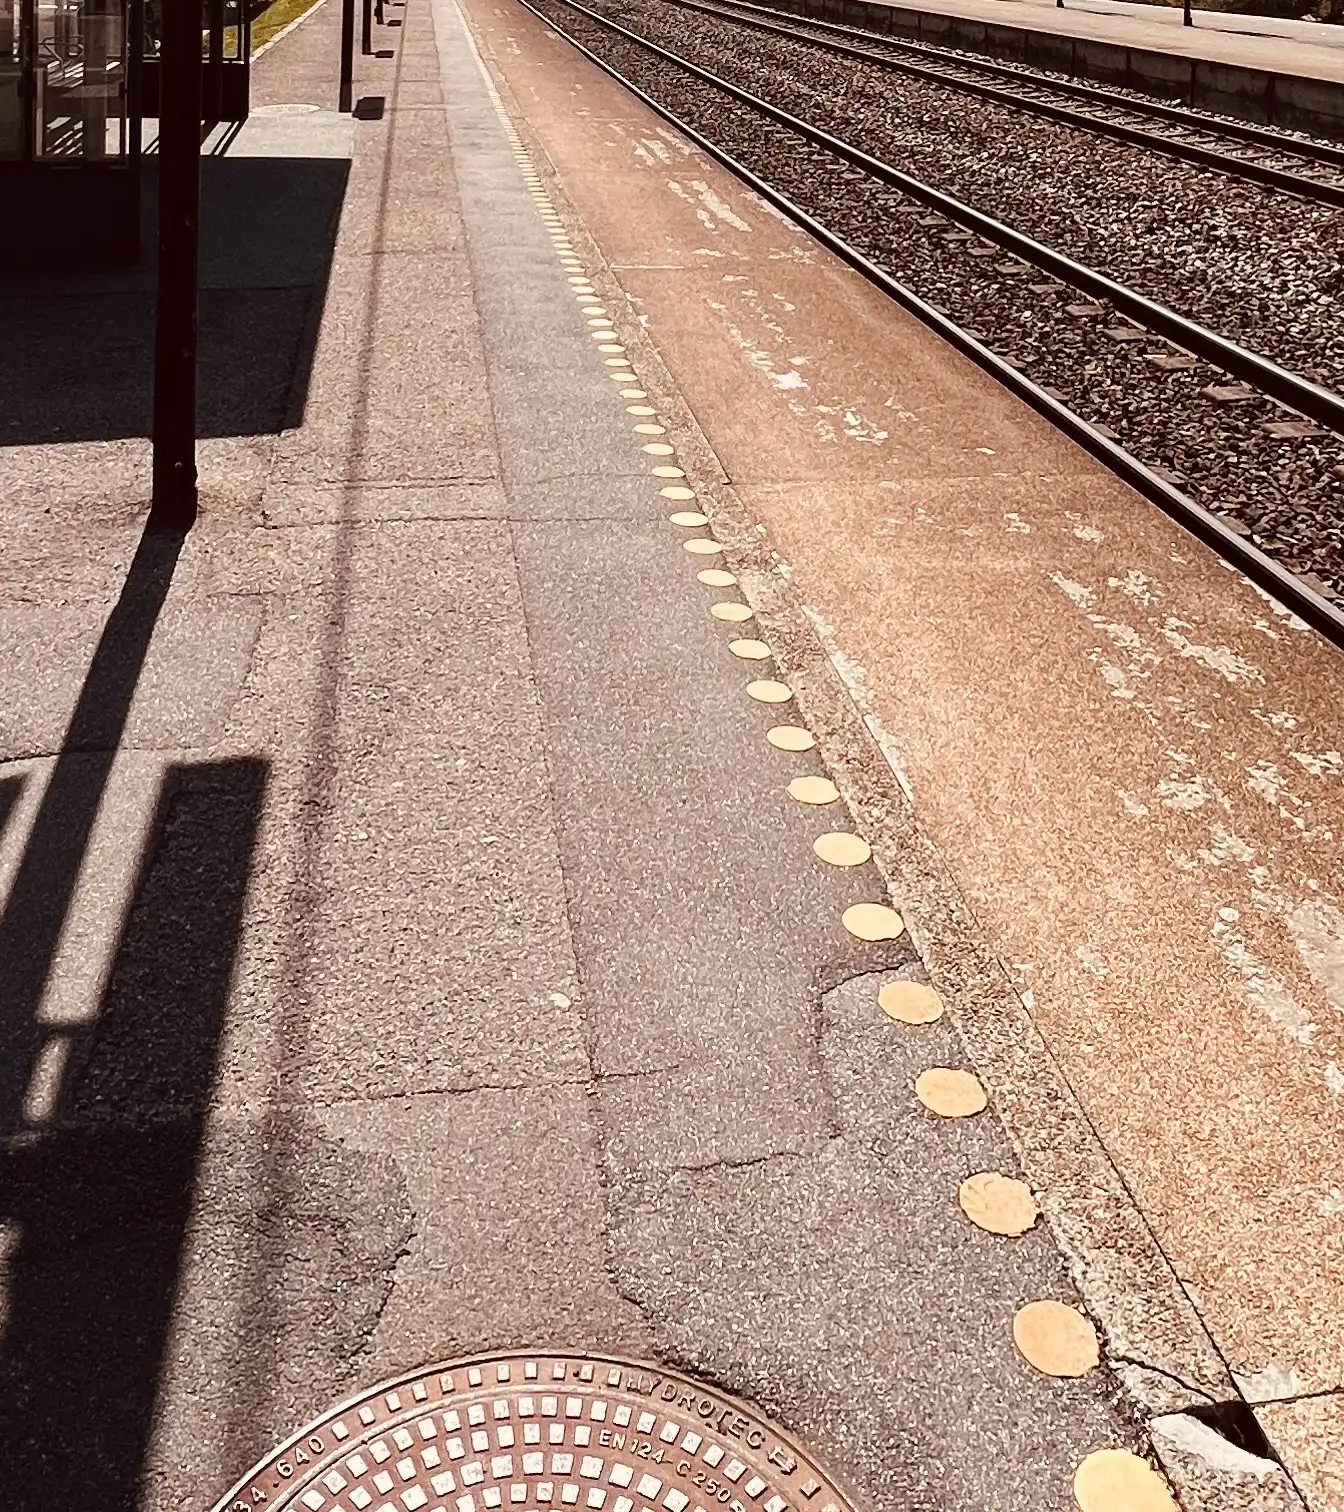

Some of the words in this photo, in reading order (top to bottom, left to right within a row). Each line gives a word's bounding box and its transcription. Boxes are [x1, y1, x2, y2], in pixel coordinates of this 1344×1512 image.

[626, 1374, 766, 1450] HYDROTEC
[599, 1428, 626, 1450] EN
[692, 1472, 732, 1504] 250
